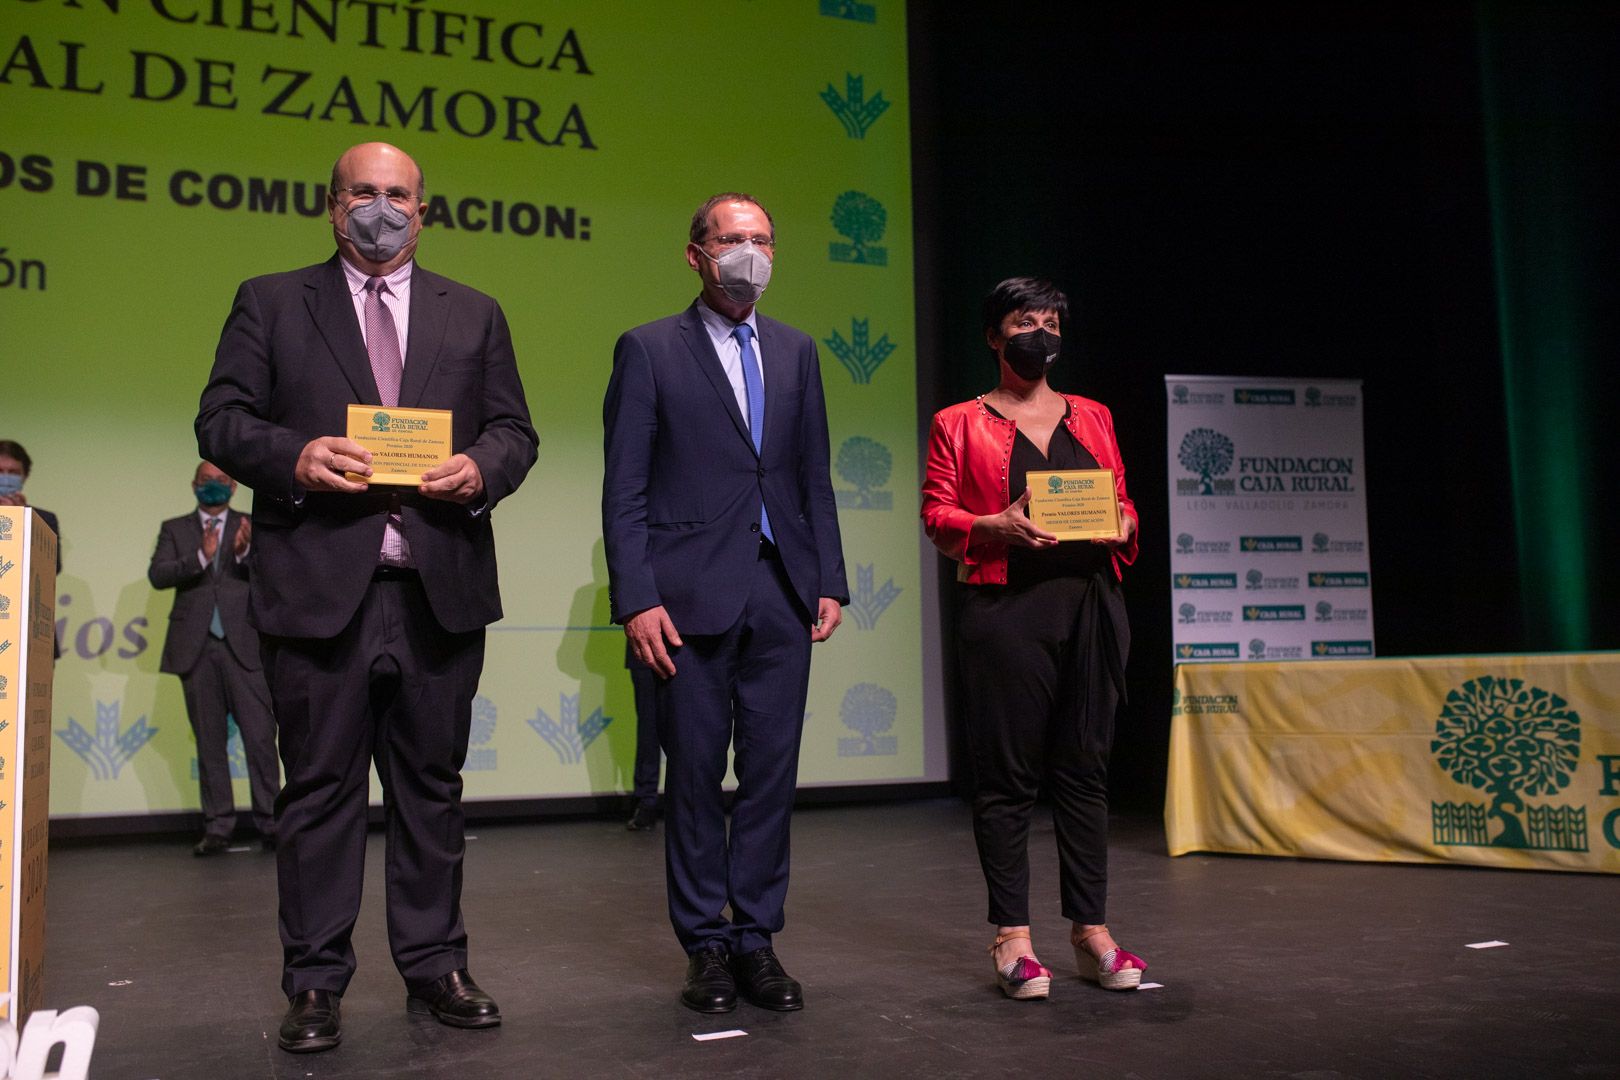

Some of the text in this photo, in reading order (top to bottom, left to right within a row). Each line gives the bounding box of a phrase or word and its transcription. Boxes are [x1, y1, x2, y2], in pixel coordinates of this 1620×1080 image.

[130, 50, 239, 110] DE
[261, 64, 598, 151] ZAMORA
[76, 160, 147, 200] DE
[1240, 475, 1355, 493] CAJA RURAL
